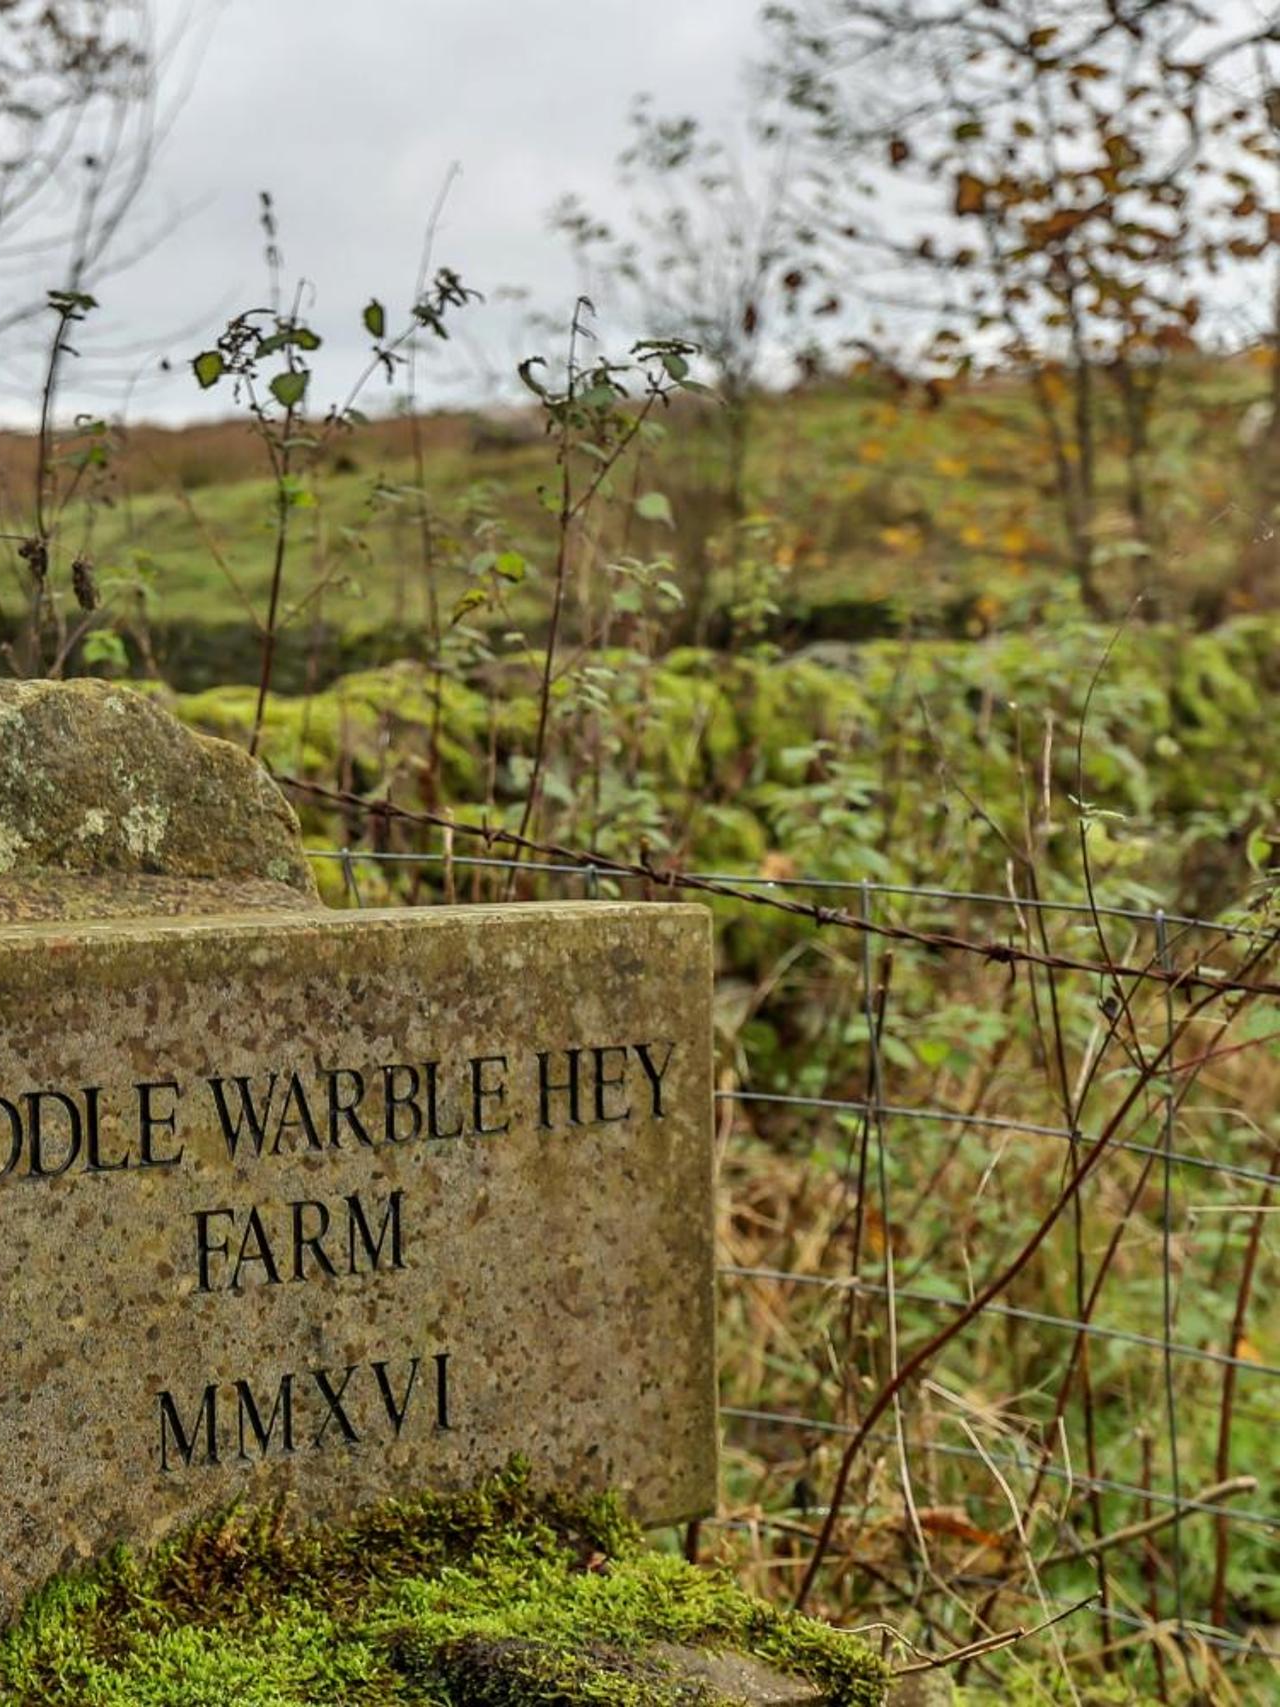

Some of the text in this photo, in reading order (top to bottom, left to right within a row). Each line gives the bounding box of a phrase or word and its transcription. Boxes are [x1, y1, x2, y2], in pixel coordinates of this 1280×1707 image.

[207, 1056, 510, 1160] WARBLE
[536, 1041, 677, 1131] HEY
[190, 1189, 408, 1295] FARM
[155, 1353, 451, 1472] MMXVI
